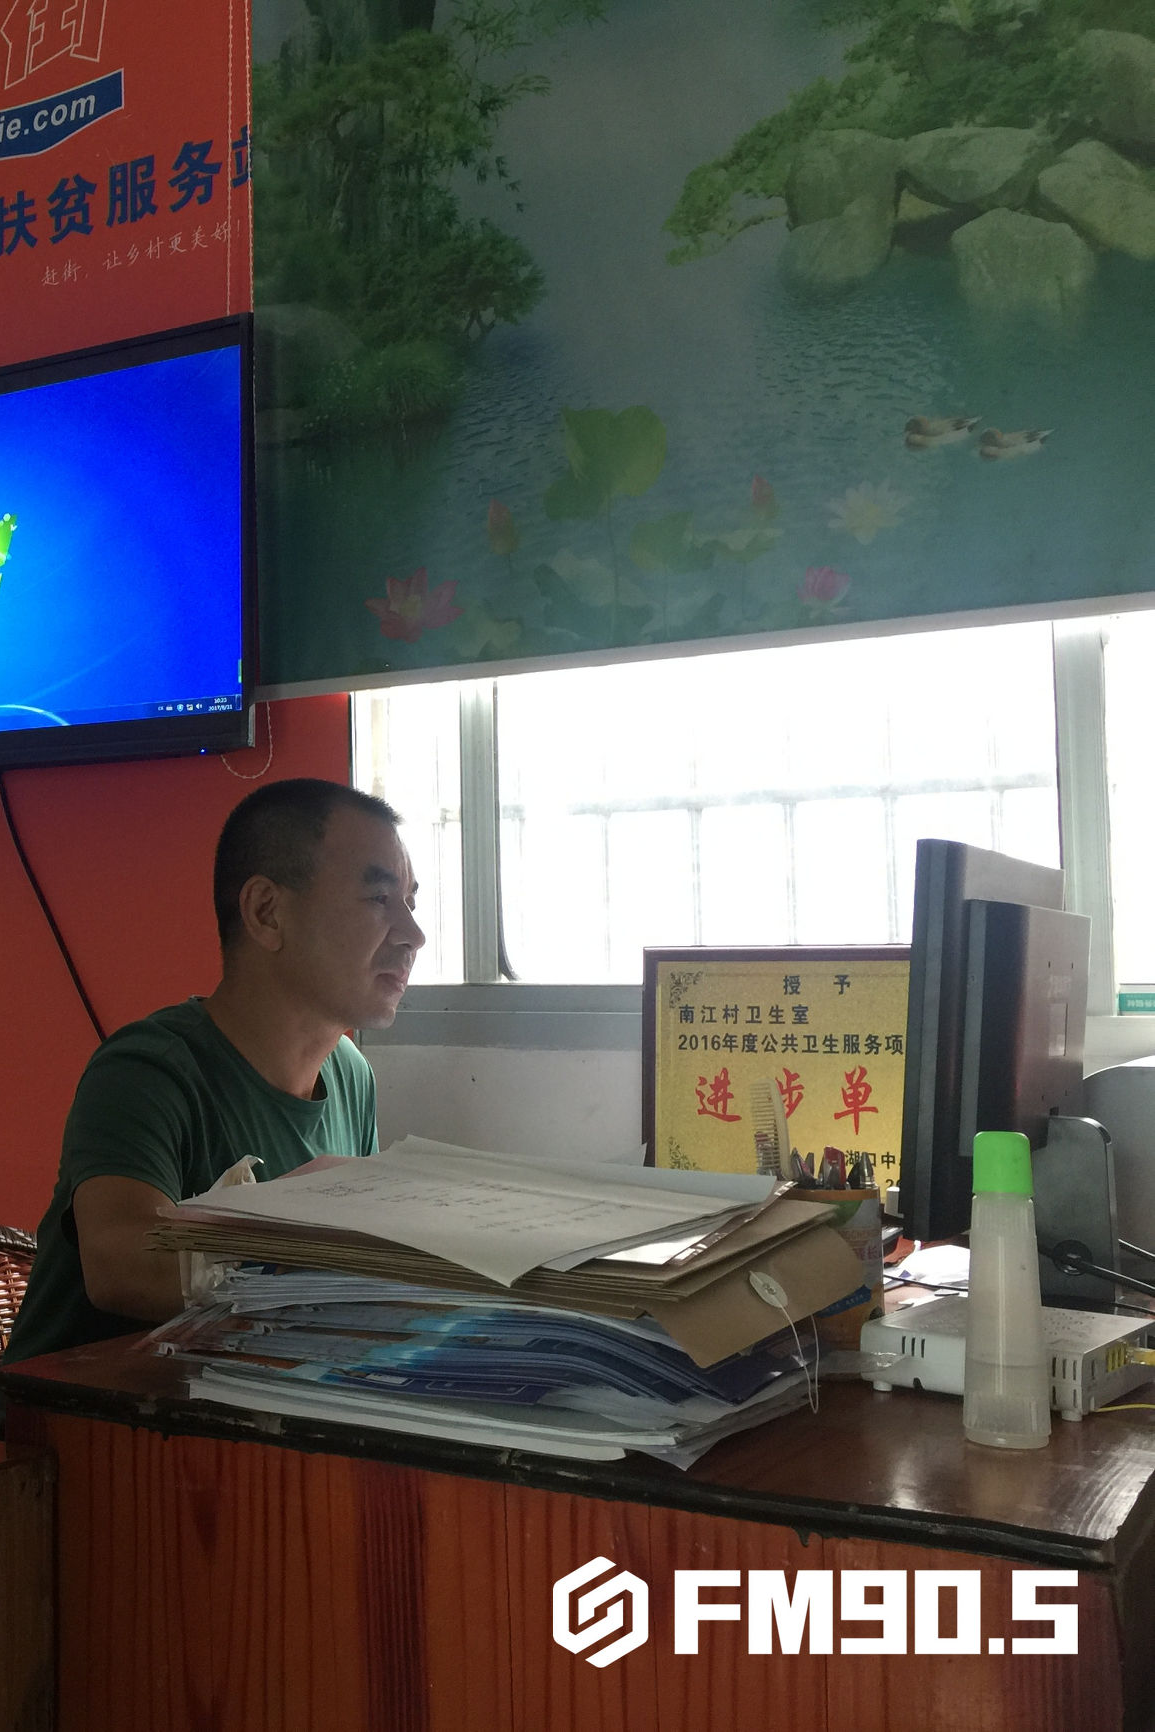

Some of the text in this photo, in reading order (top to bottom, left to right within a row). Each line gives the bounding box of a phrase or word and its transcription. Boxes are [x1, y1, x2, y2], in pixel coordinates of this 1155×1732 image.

[679, 1004, 810, 1025] 南江村卫生室
[678, 1033, 904, 1056] 2016年度公共卫生服务项
